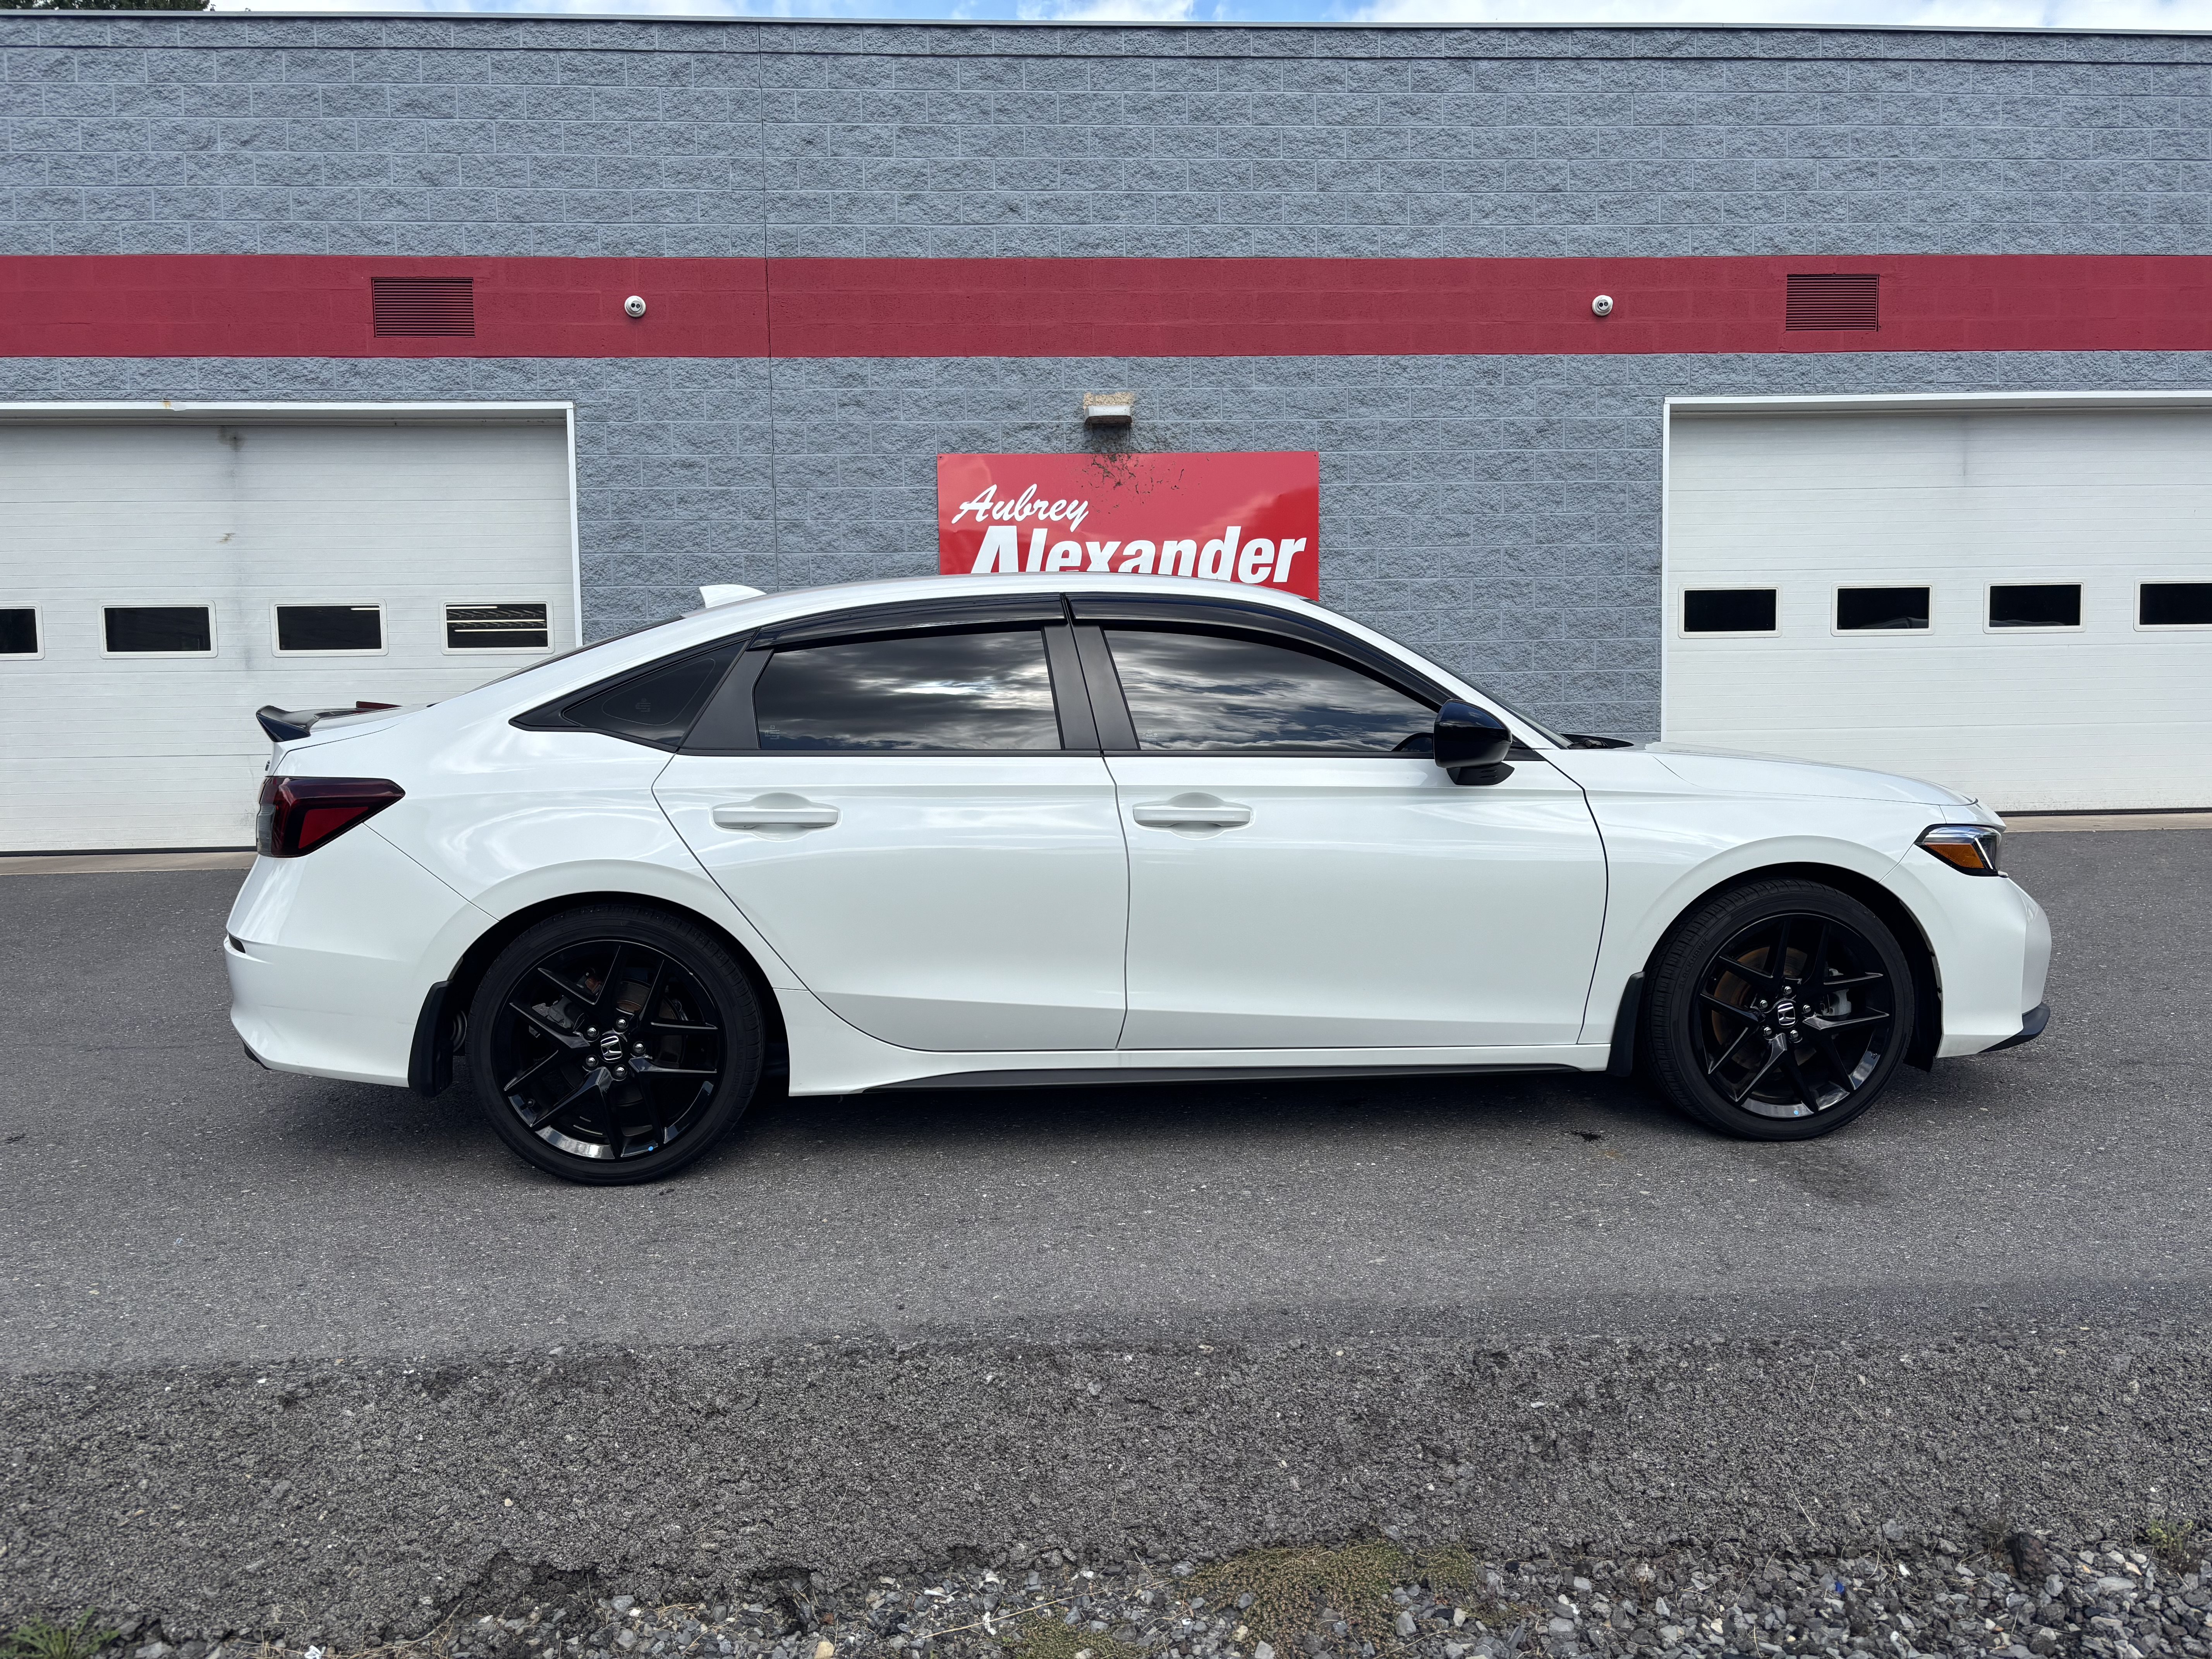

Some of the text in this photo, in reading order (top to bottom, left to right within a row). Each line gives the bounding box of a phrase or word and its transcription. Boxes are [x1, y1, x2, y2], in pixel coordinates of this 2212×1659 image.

[951, 483, 1089, 532] Aubrey
[970, 526, 1307, 584] Alexander
[1678, 938, 1708, 990] BLACKHAWK
